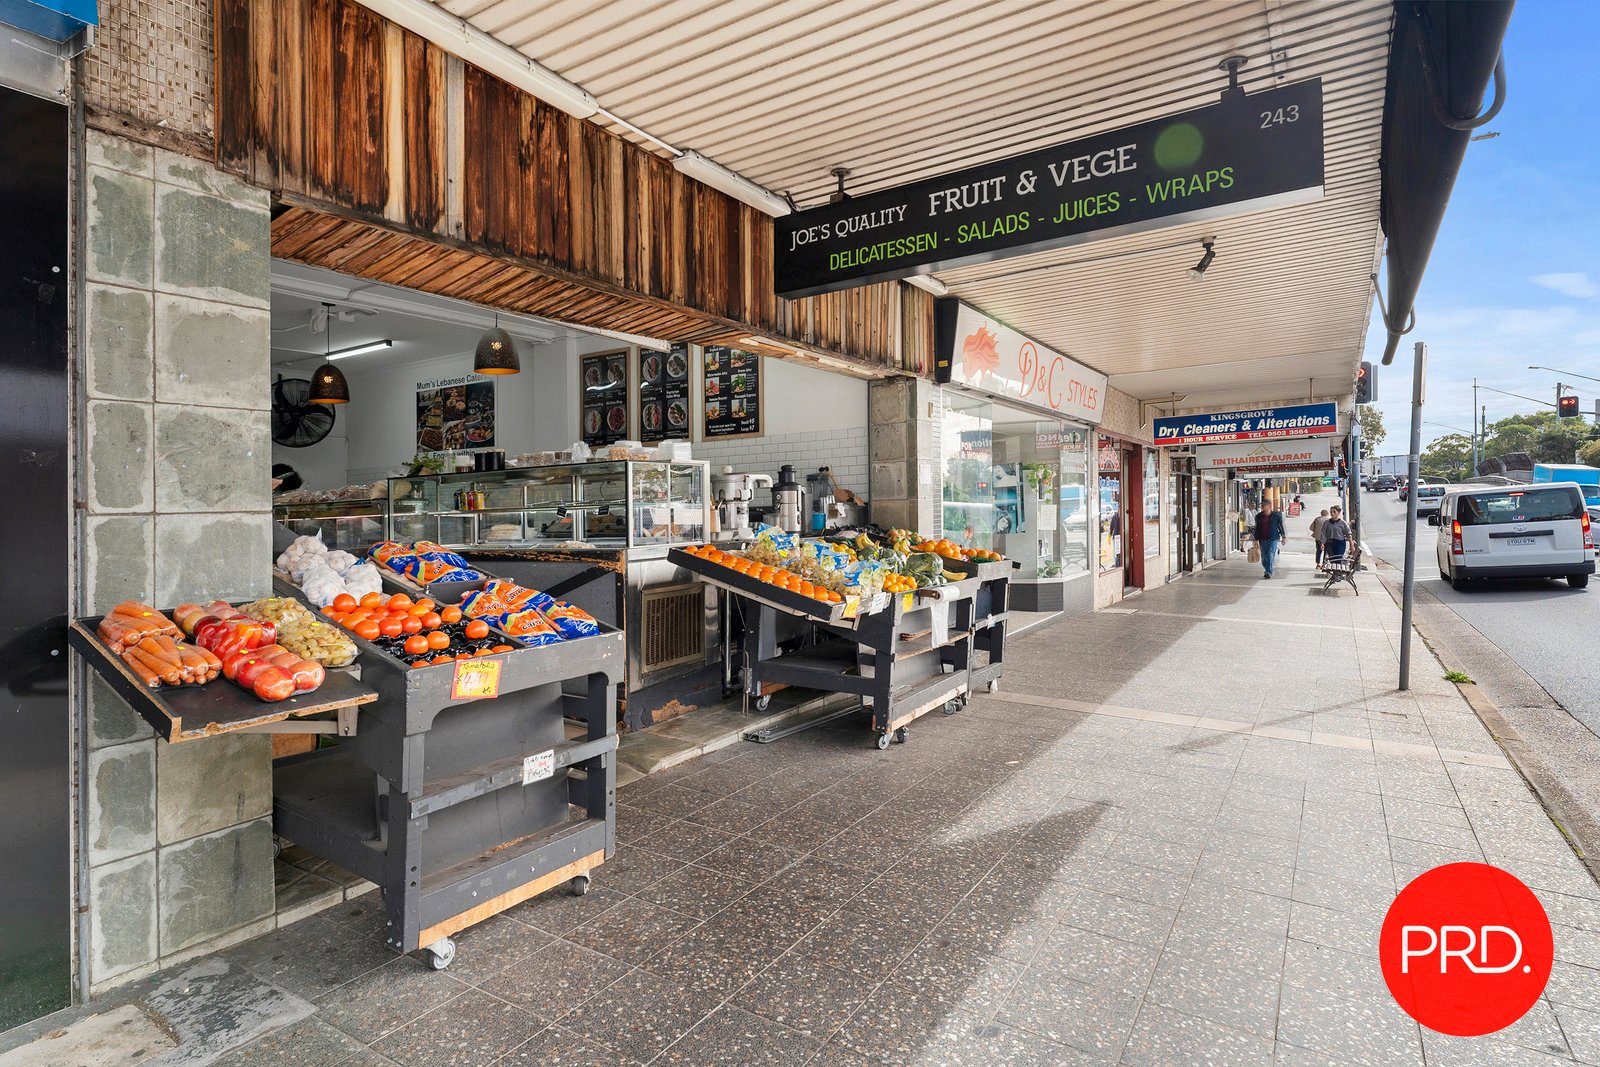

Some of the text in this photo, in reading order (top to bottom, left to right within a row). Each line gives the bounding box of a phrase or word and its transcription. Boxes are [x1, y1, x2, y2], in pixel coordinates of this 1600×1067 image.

[1260, 104, 1301, 130] 243
[789, 143, 1137, 252] JOE'S QUALITY FRUIT & VEGE
[829, 231, 938, 271] DELICATESSEN
[957, 210, 1030, 244] SALADS
[1053, 191, 1121, 224] JUICES
[1145, 166, 1234, 205] WRAPS
[416, 381, 435, 390] Mum's
[436, 376, 465, 387] Lebanese
[1067, 379, 1098, 410] STYLES
[1210, 409, 1274, 422] KINGSGROVE
[1158, 414, 1330, 438] Dry Cleaners & Alterations
[1205, 434, 1237, 442] SERVICE
[456, 449, 475, 457] within
[1211, 458, 1227, 466] TIN
[1227, 456, 1250, 465] THAI
[1250, 452, 1313, 464] RESTAURANT
